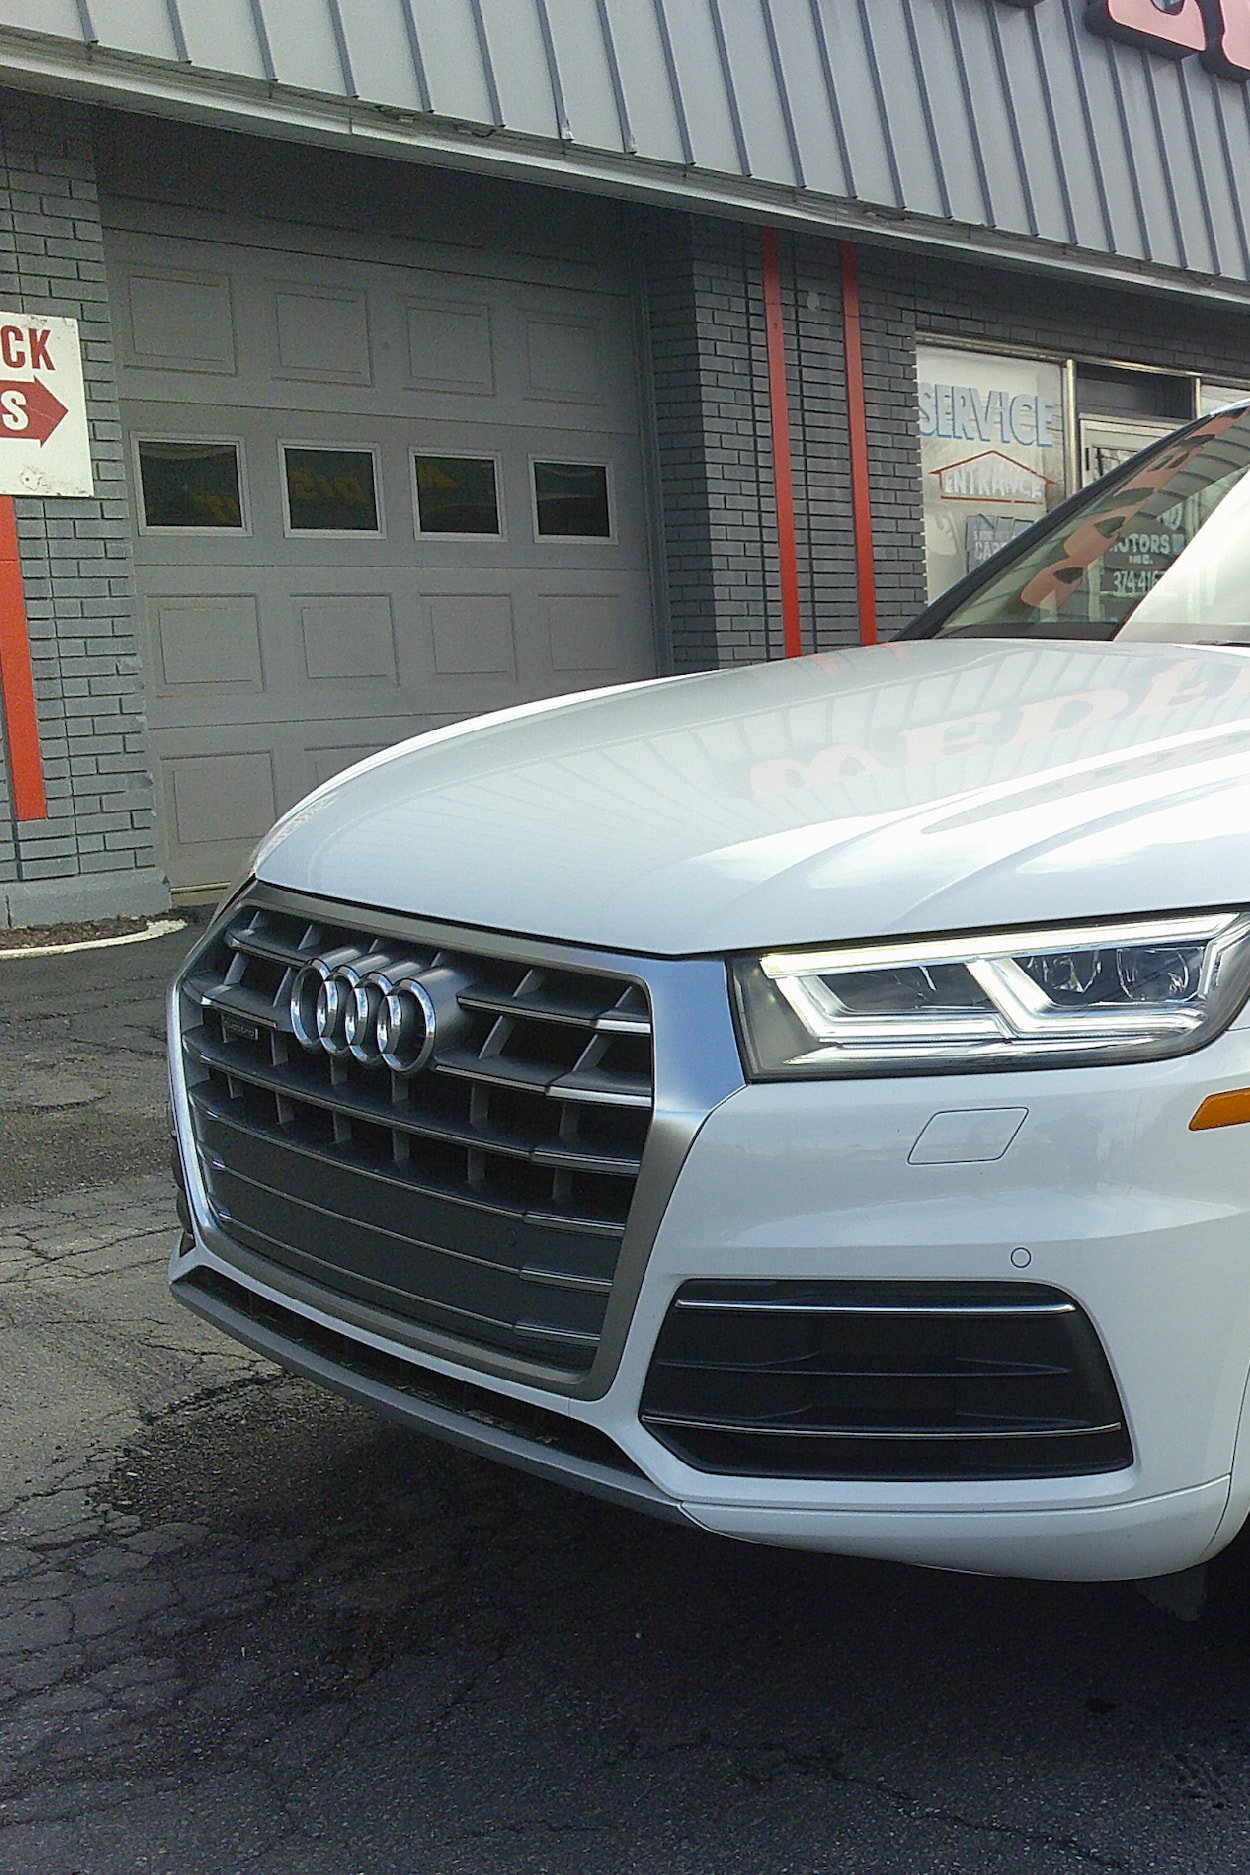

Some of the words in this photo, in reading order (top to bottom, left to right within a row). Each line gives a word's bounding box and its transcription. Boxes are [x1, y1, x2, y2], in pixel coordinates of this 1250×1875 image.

[0, 325, 56, 371] CK
[1, 390, 29, 431] S
[918, 382, 1053, 447] SERVICE
[944, 462, 1042, 498] ENTRANCE
